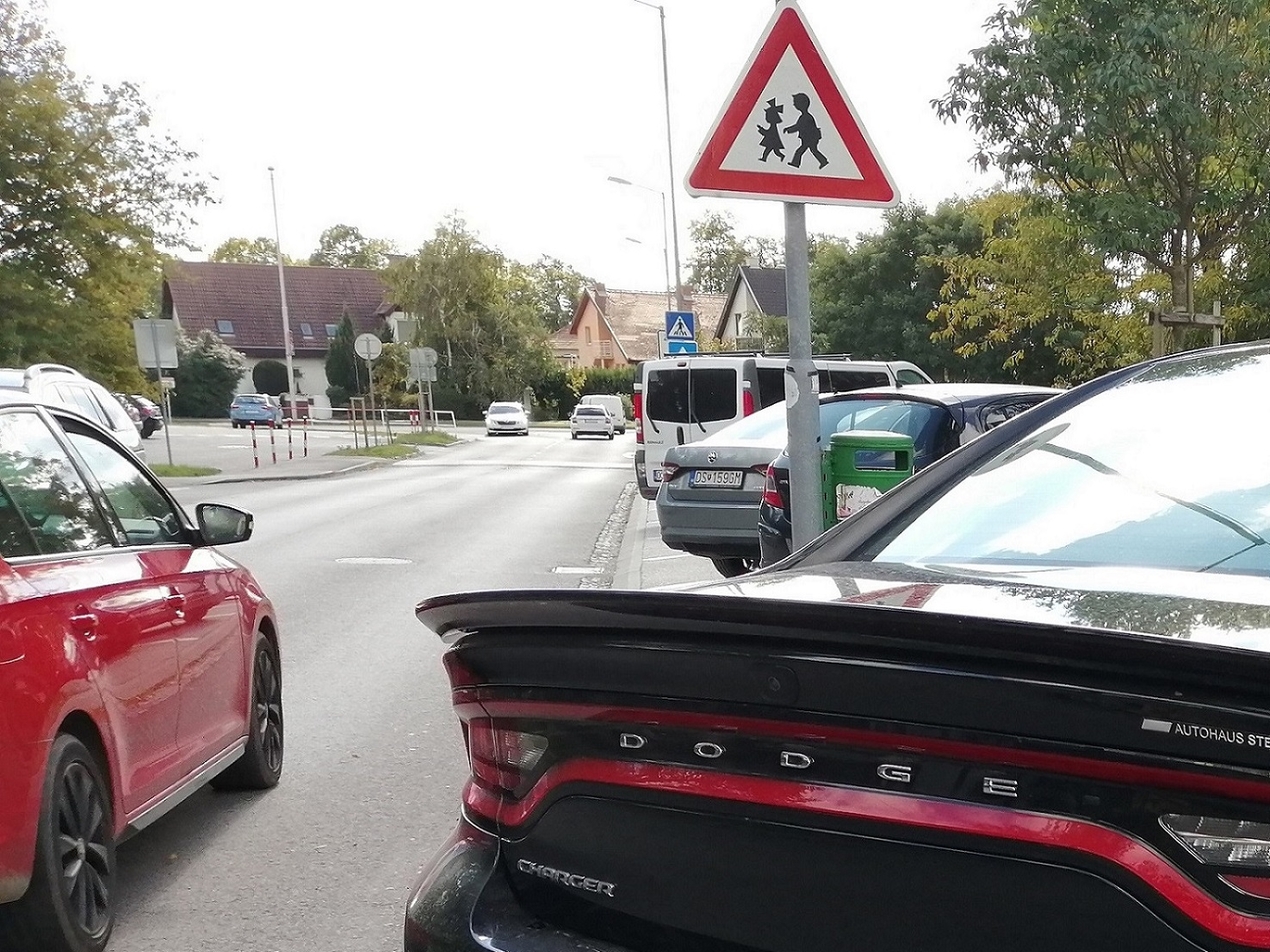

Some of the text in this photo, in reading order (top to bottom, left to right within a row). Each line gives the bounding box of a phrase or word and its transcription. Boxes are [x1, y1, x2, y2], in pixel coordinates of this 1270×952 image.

[1174, 723, 1245, 745] AUTOHAUS
[619, 732, 1019, 798] DODGE
[517, 858, 618, 898] CHARGER
